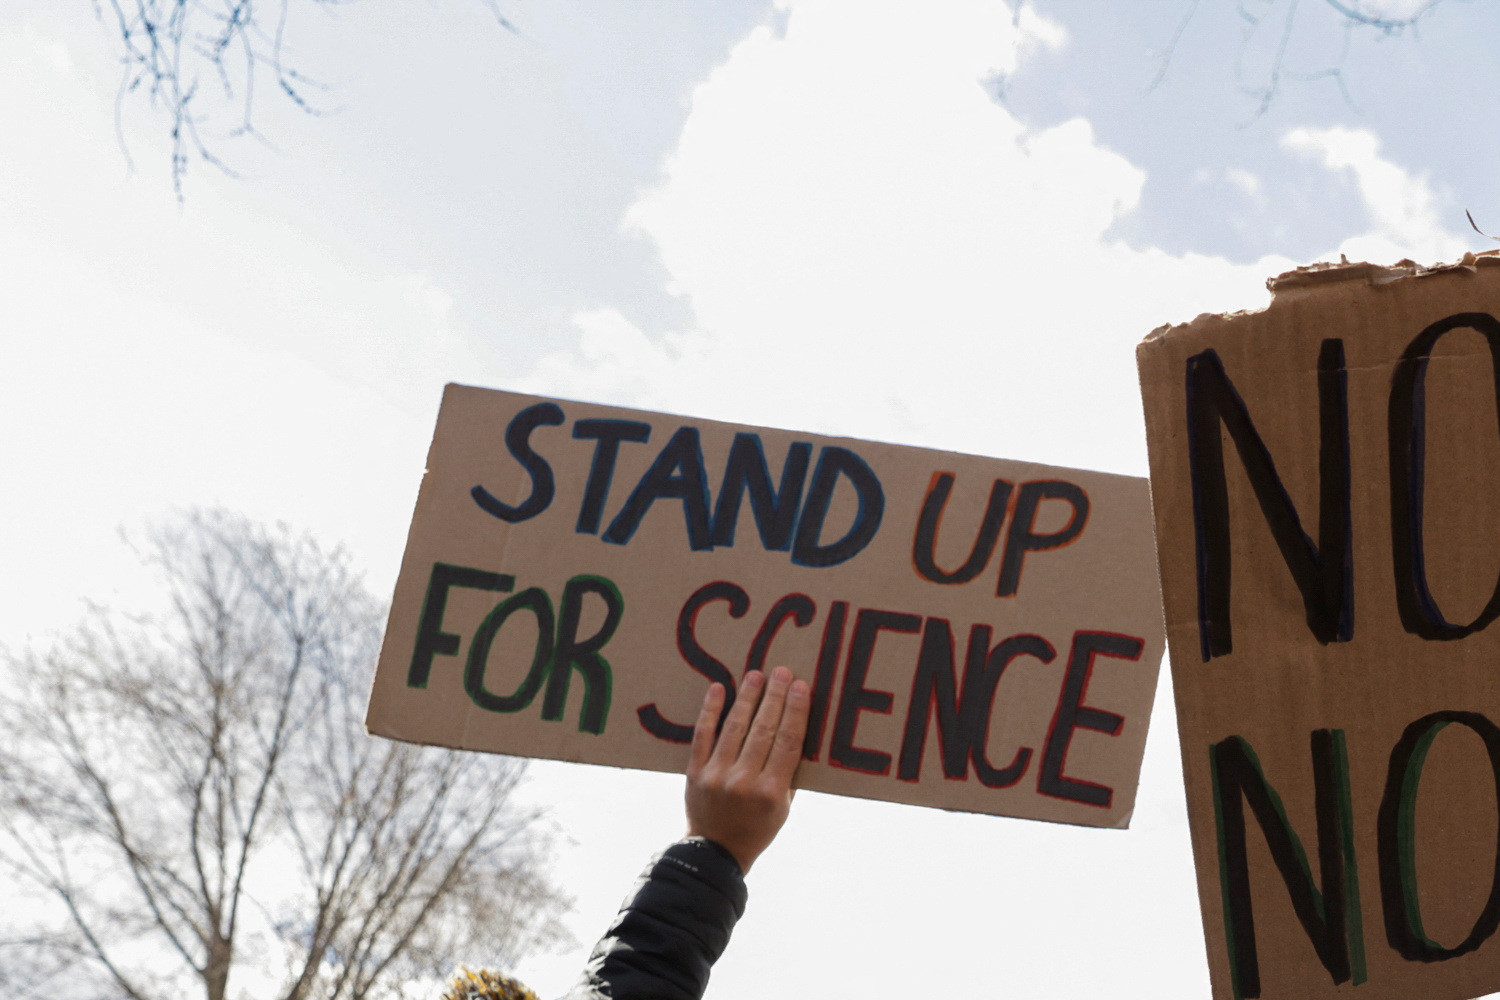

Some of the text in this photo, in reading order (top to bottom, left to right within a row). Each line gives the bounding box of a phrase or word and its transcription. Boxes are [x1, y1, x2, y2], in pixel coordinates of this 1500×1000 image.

[470, 402, 1091, 598] STAND UP
[406, 561, 625, 736] FOR
